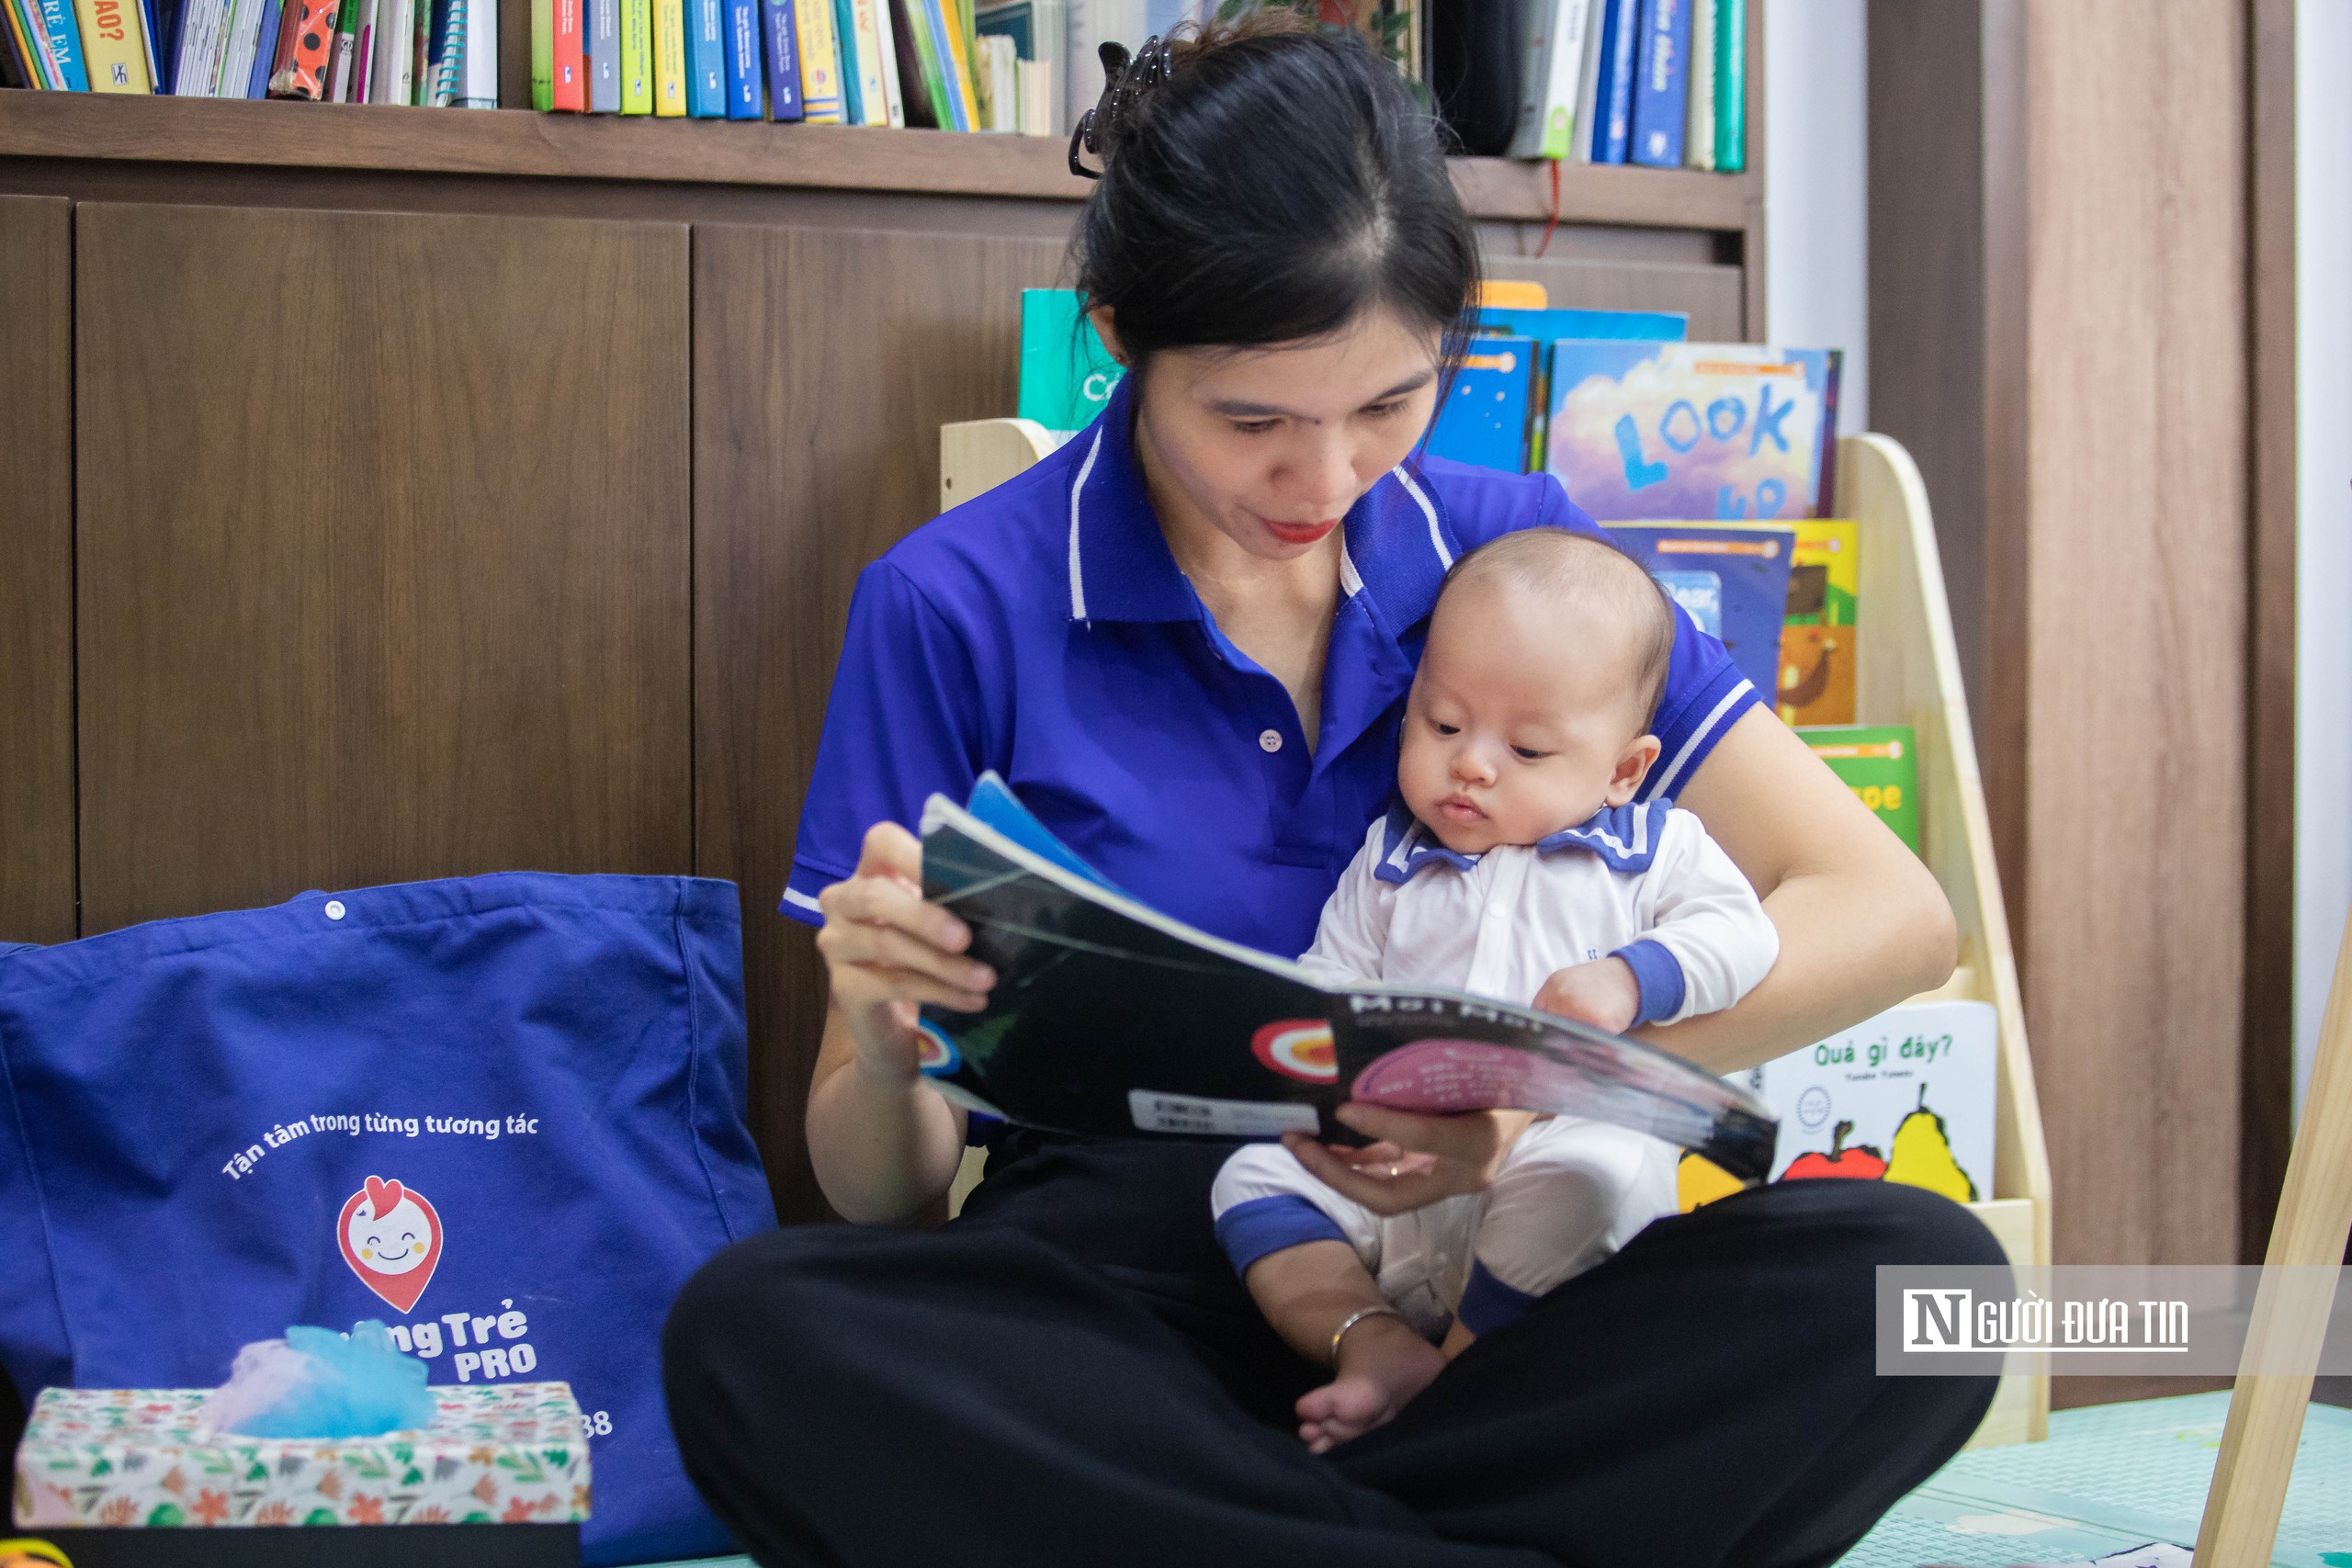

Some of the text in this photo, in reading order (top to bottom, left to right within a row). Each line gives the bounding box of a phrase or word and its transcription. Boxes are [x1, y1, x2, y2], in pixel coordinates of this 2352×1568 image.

[51, 34, 72, 63] EM
[1815, 1040, 1855, 1066] Quả
[222, 1112, 538, 1180] Tận tâm trong từng tương tác
[454, 1343, 537, 1382] PRO
